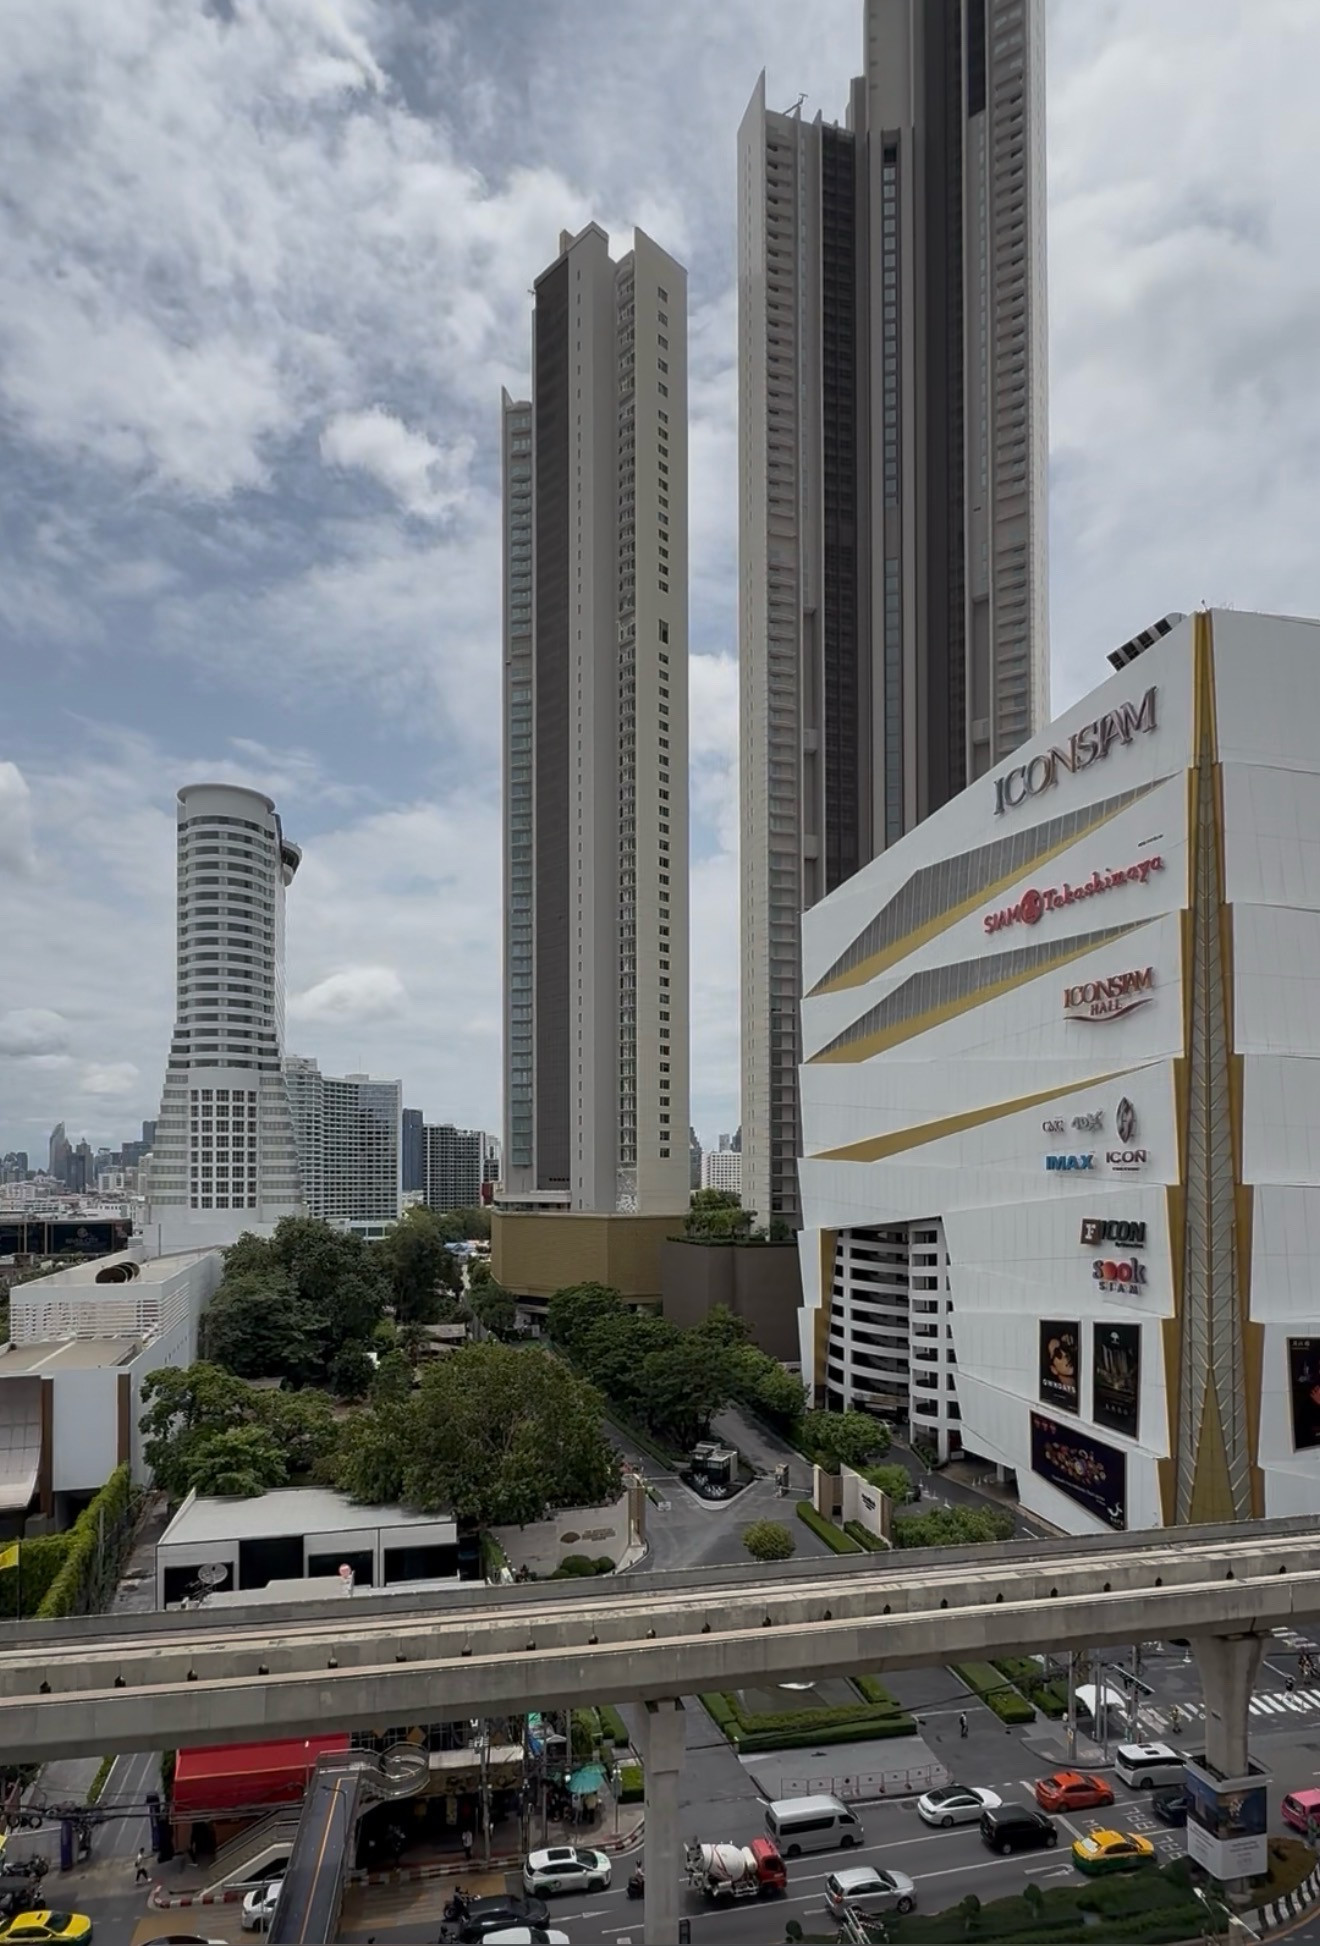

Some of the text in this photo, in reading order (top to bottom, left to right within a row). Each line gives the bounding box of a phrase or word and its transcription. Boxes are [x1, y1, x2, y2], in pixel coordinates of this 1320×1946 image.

[994, 686, 1157, 815] ICONSIAM
[984, 856, 1164, 933] SIAM Takashimaya
[1063, 966, 1153, 1008] ICONSIAM
[1090, 1000, 1122, 1015] HALL
[1046, 1154, 1094, 1170] IMAX
[1106, 1150, 1147, 1163] ICON
[1099, 1282, 1138, 1295] SIAM
